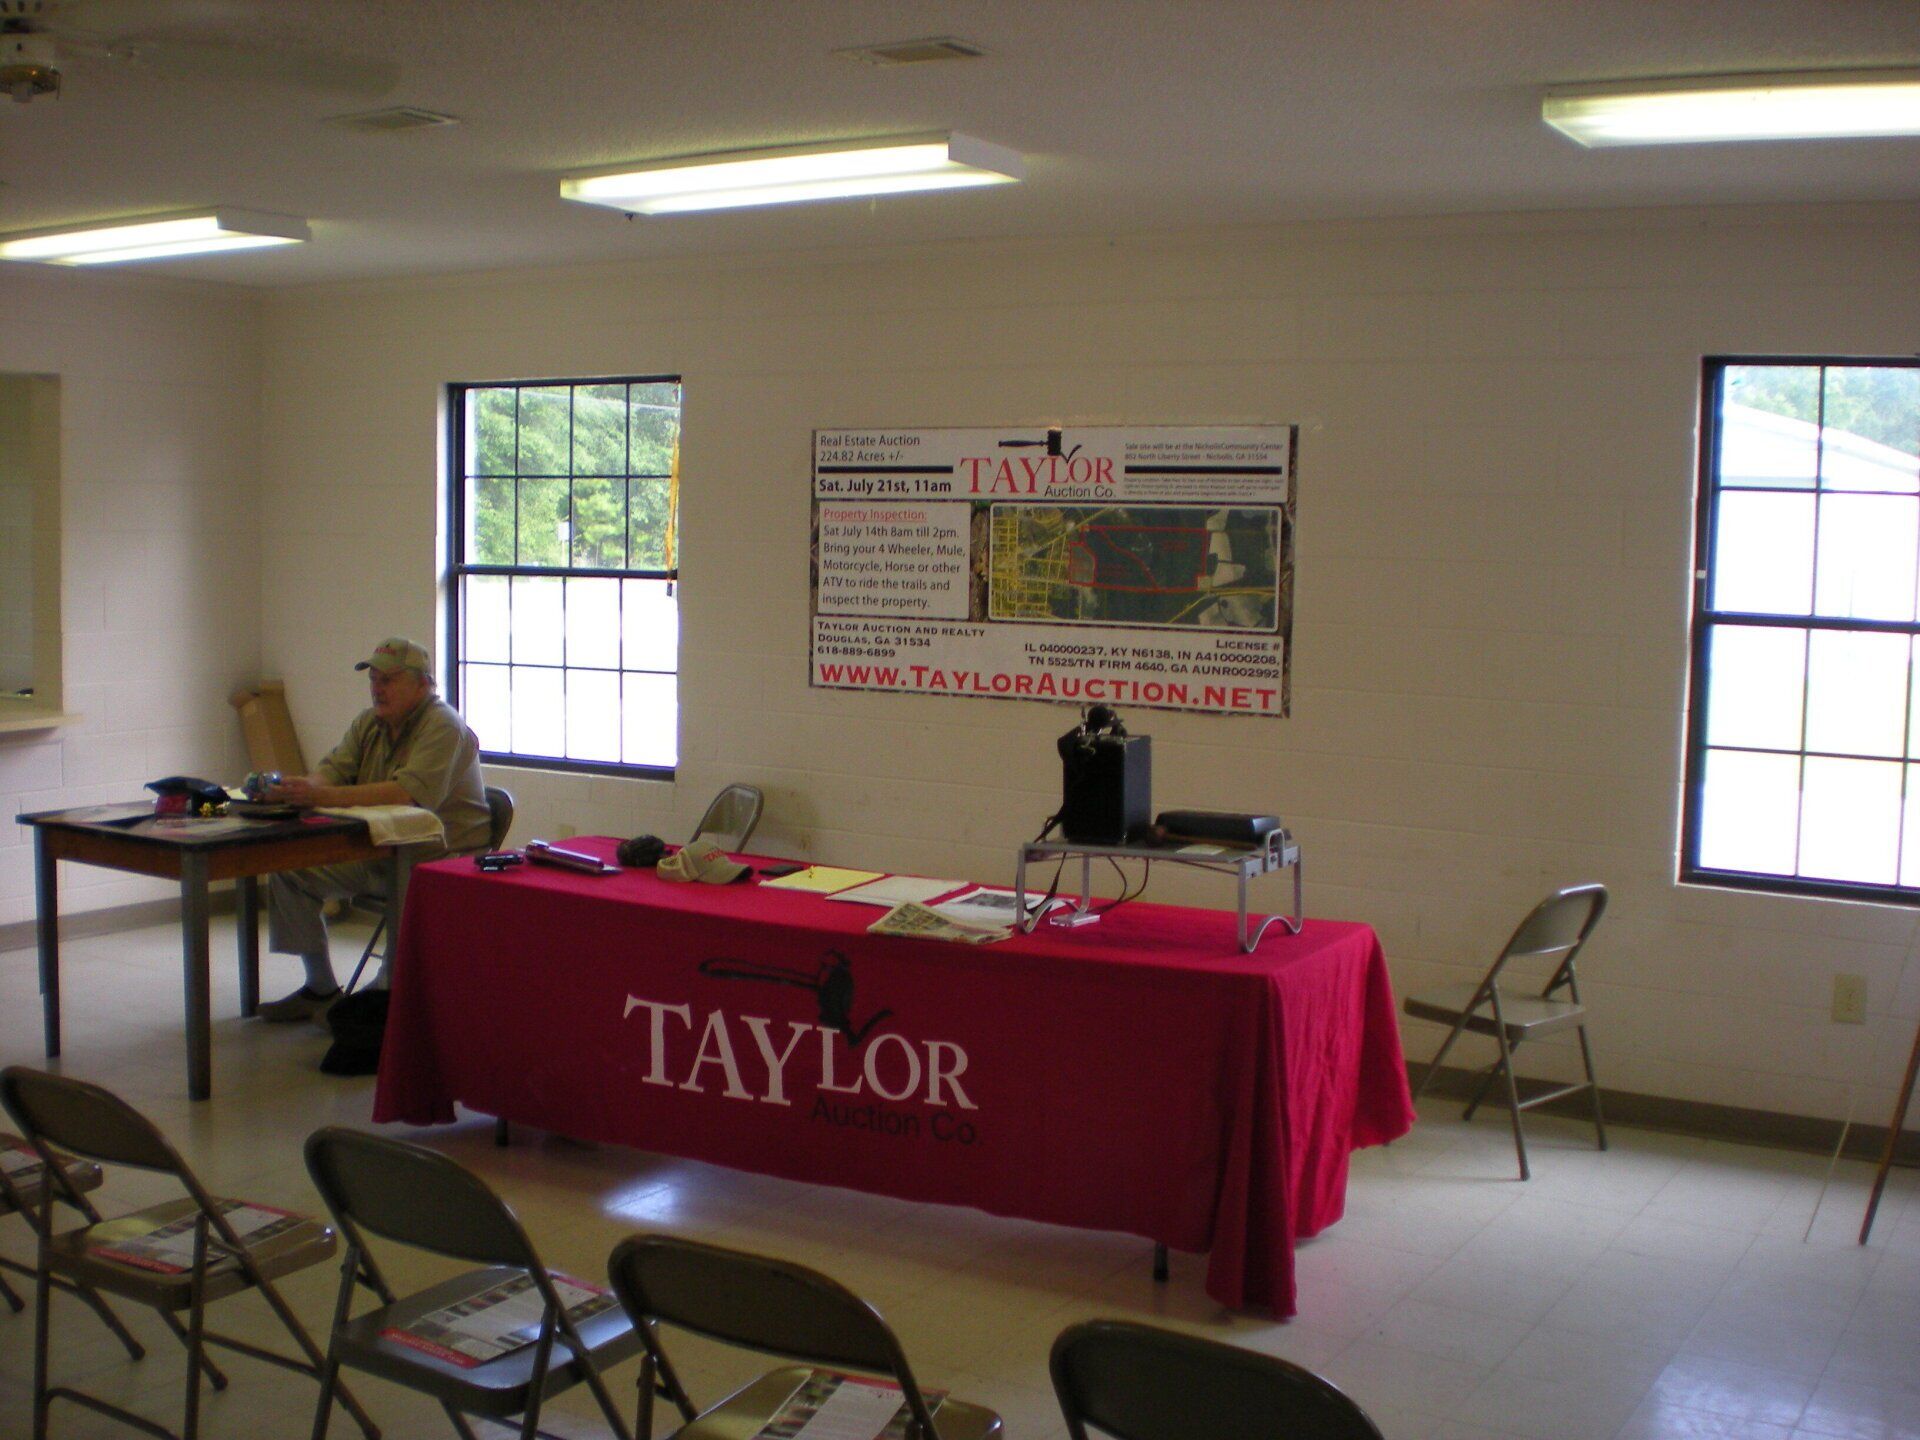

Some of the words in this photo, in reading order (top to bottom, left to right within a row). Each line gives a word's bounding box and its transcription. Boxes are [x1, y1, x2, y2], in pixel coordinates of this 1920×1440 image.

[821, 435, 841, 446] Real
[845, 435, 875, 446] Estate
[879, 435, 920, 445] Auction
[821, 451, 854, 461] 224.82
[857, 451, 885, 461] Acres
[960, 456, 1117, 493] TAYLOR
[819, 479, 843, 492] Sat.
[847, 479, 873, 495] July
[878, 480, 909, 493] 21st,
[915, 480, 951, 492] 11am
[1044, 485, 1090, 497] Auction
[1095, 486, 1116, 497] Co.
[824, 509, 867, 521] Property
[870, 509, 927, 521] Inspection:
[824, 526, 839, 536] Sat
[842, 526, 861, 538] July
[866, 526, 887, 537] 14th
[891, 527, 912, 537] 8am
[916, 527, 929, 538] till
[932, 528, 959, 539] 2pm.
[824, 543, 850, 556] Bring
[853, 545, 875, 556] your
[879, 544, 885, 553] 4
[888, 544, 933, 556] Wheeler,
[936, 545, 965, 557] Mule,
[824, 560, 882, 573] Motorcycle,
[885, 561, 914, 572] Horse
[918, 564, 928, 572] or
[932, 563, 960, 573] other
[823, 577, 842, 587] ATV
[846, 578, 856, 588] to
[859, 578, 878, 588] ride
[882, 579, 898, 589] the
[902, 579, 927, 590] trails
[930, 580, 950, 591] and
[823, 595, 859, 606] inspect
[862, 595, 878, 605] the
[882, 597, 930, 609] property.
[818, 621, 859, 632] TAYLOR
[863, 623, 911, 634] AUCTION
[915, 626, 938, 635] AND
[942, 628, 985, 637] REALTY
[818, 633, 870, 645] DOUGLAS,
[895, 637, 930, 647] 31534
[1216, 640, 1268, 651] LICENSE
[817, 646, 895, 657] 618-889-6899
[1025, 643, 1036, 652] IL
[1039, 644, 1107, 656] 040000237,
[1111, 647, 1128, 657] KY
[1132, 649, 1174, 661] N6138,
[1178, 651, 1191, 661] IN
[1196, 652, 1280, 666] A410000208,
[1029, 656, 1044, 665] TN
[1048, 657, 1094, 668] 5525/TN
[1100, 659, 1131, 670] FIRM
[1135, 661, 1168, 673] 4640,
[1171, 663, 1188, 673] GA
[623, 993, 979, 1110] TAYLOR
[810, 1096, 920, 1137] Auction
[932, 1111, 981, 1145] Co.
